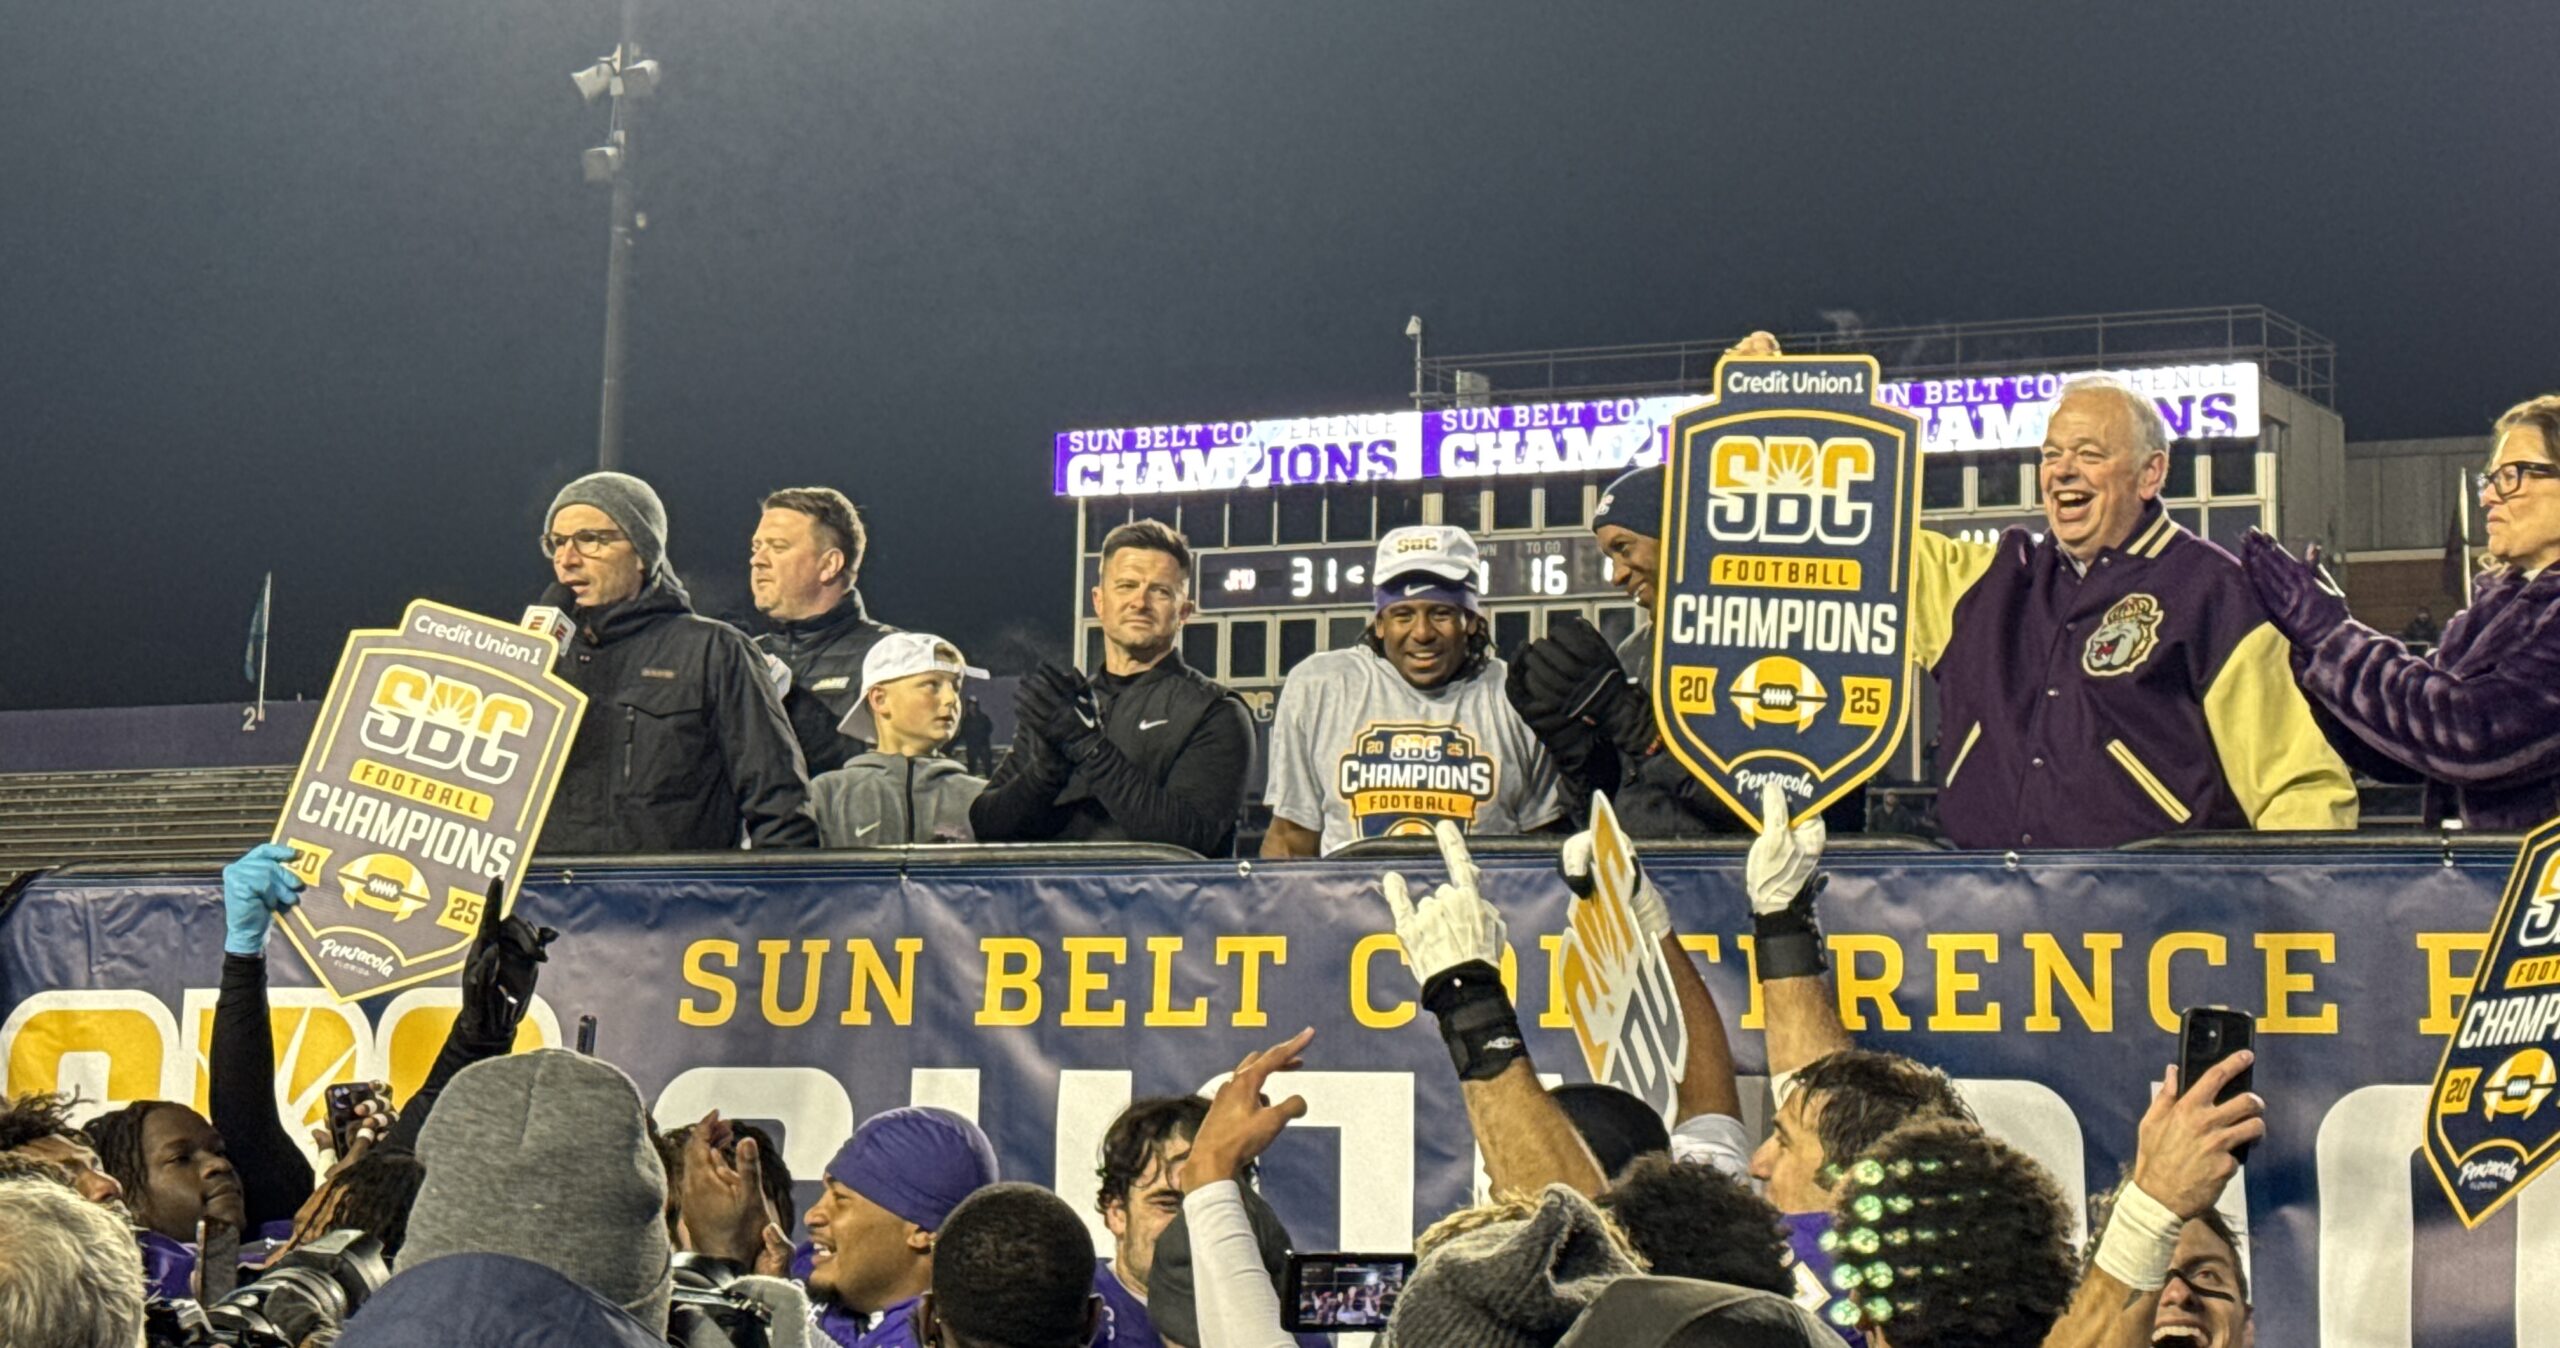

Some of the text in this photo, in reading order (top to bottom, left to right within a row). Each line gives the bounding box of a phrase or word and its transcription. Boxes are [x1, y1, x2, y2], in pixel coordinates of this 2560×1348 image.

[1728, 370, 1790, 393] Credit
[1923, 377, 2004, 405] BELT
[1441, 406, 1500, 432] SUN
[1513, 401, 1586, 428] BELT
[1069, 428, 1125, 453] SUN
[1134, 424, 1202, 450] BELT
[1707, 435, 1875, 545] SBC
[1397, 537, 1438, 554] SBC
[1526, 541, 1561, 554] TO GO
[1291, 556, 1338, 597] 31
[1531, 554, 1568, 596] 16
[1722, 559, 1849, 585] FOOTBALL
[414, 615, 472, 647] Credit
[1671, 594, 1898, 655] CHAMPIONS
[1679, 675, 1708, 703] 20
[1850, 686, 1881, 715] 25
[360, 664, 534, 785] SBC
[1366, 740, 1384, 755] 20
[1389, 734, 1442, 762] SBC
[361, 764, 480, 814] FOOTBALL
[1341, 760, 1491, 795] CHAMPIONS
[1369, 794, 1457, 812] FOOTBALL
[298, 781, 517, 879] CHAMPIONS
[448, 897, 482, 925] 25
[319, 938, 394, 978] Pensacola
[2514, 960, 2560, 983] FOOT
[678, 937, 923, 1027] SUN
[974, 935, 1288, 1027] BELT
[2445, 1076, 2472, 1103] 20
